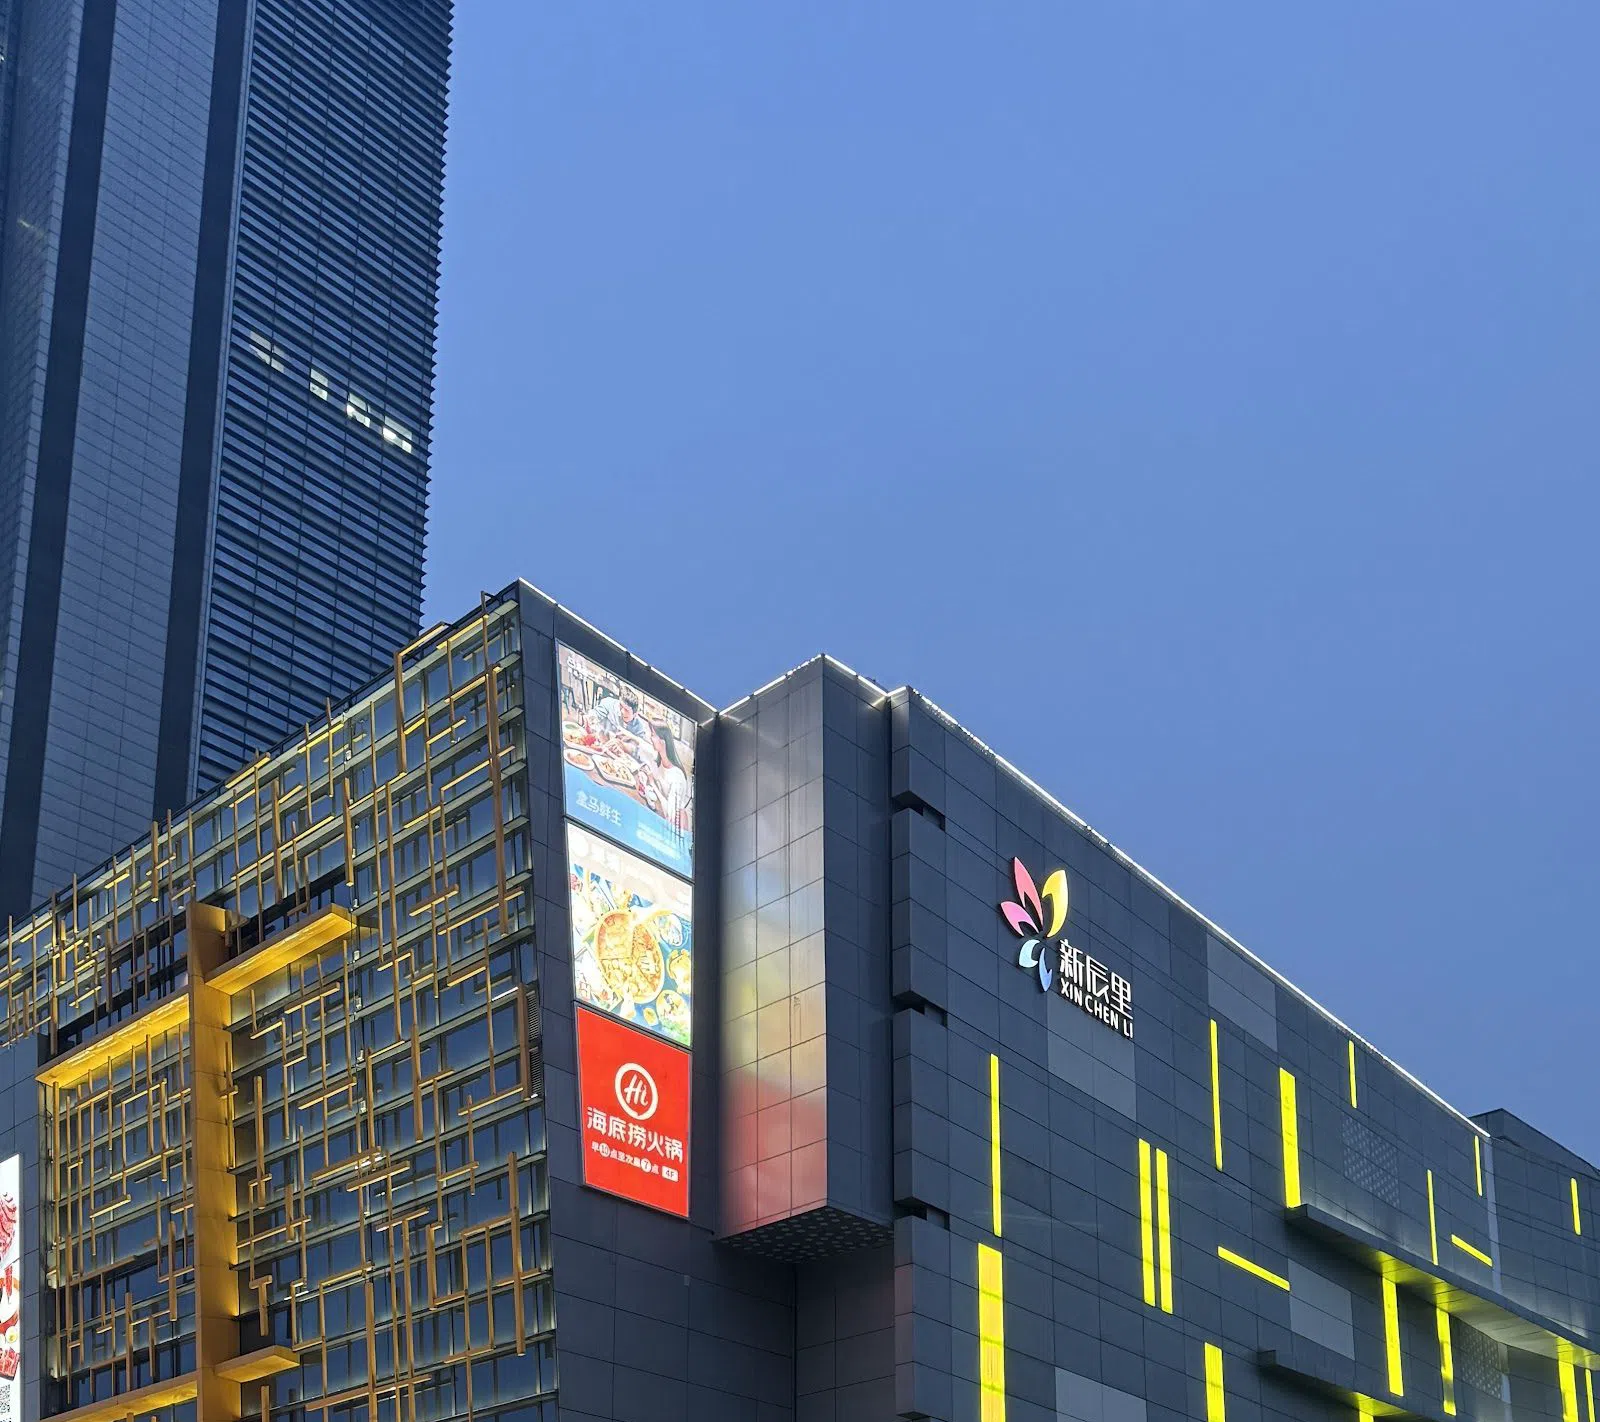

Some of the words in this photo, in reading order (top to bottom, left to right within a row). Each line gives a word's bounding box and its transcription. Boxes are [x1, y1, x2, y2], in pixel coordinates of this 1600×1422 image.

[575, 790, 622, 828] 盒马鲜生
[1059, 938, 1133, 1019] 新辰里
[623, 1073, 649, 1106] Hi
[586, 1106, 684, 1164] 海底捞火锅
